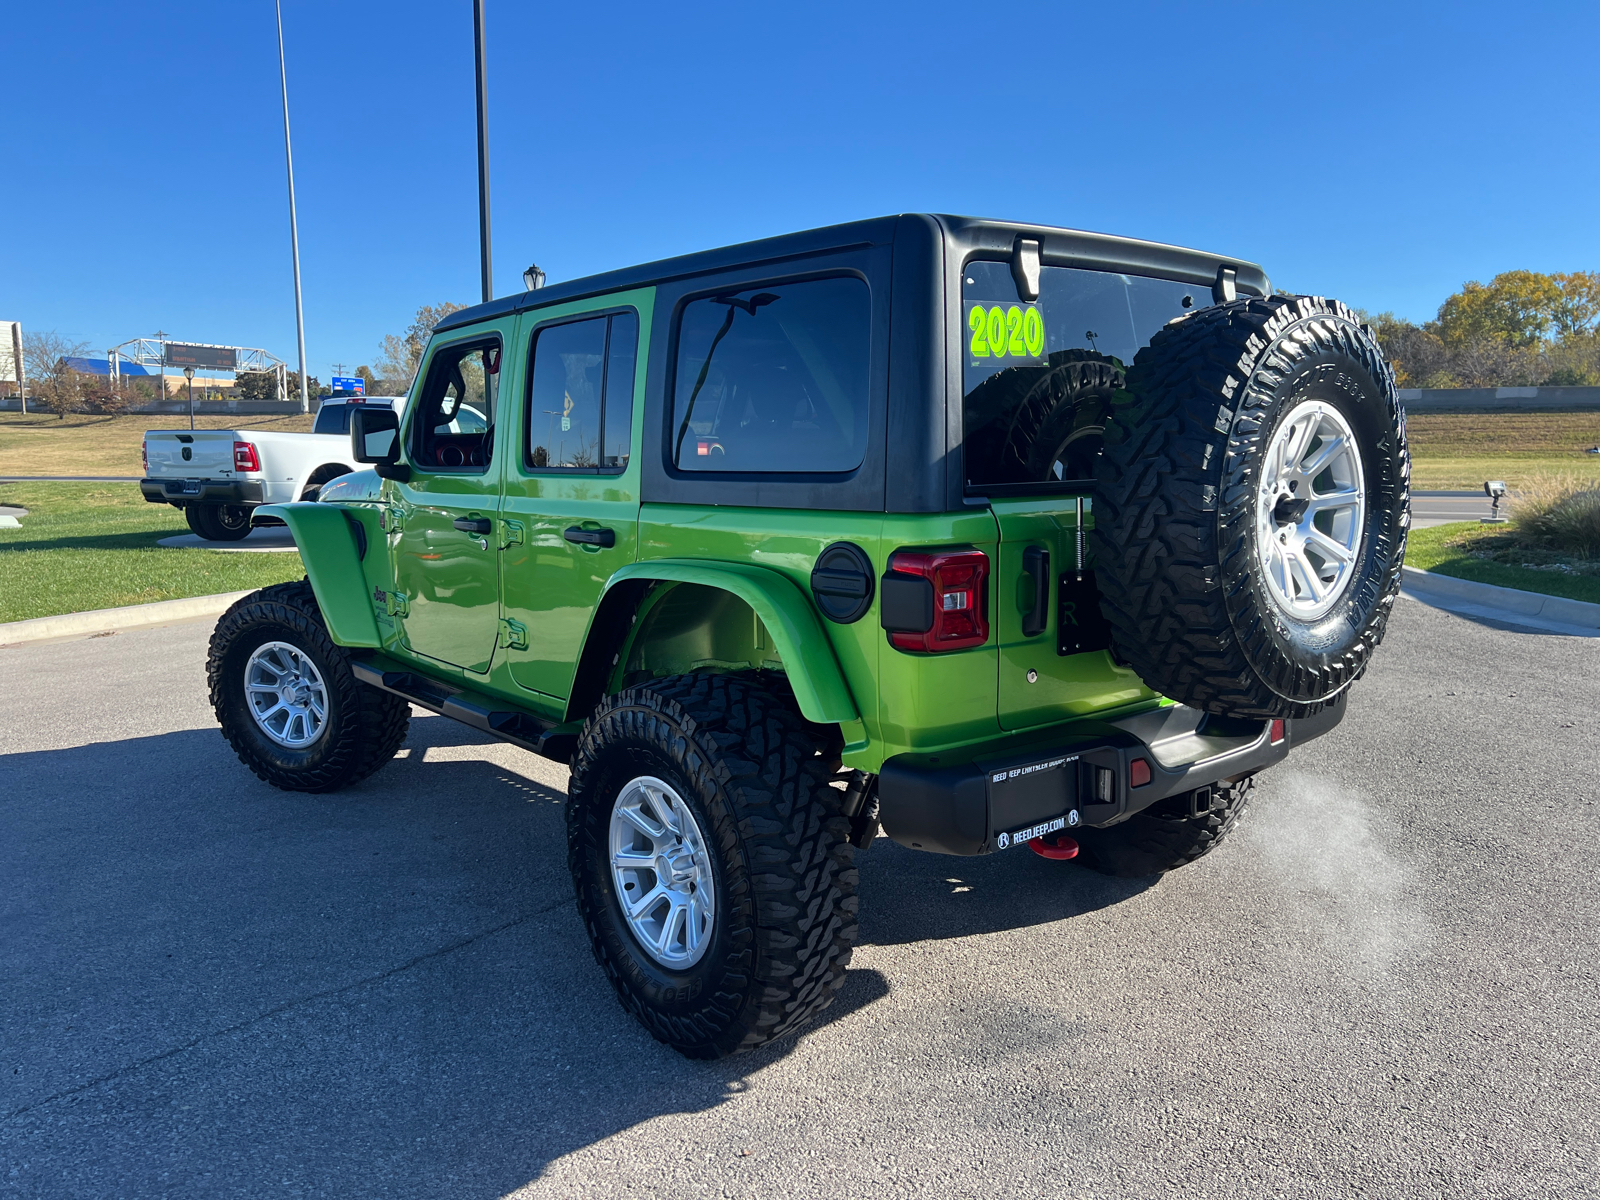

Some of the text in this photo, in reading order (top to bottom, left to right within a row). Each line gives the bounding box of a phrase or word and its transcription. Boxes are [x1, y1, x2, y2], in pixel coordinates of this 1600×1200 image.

[969, 305, 1044, 358] 2020
[1346, 430, 1396, 631] YOKOHAMA
[992, 771, 1007, 783] REED
[1008, 768, 1021, 778] JEEP
[1013, 817, 1065, 845] REEDJEEP.COM
